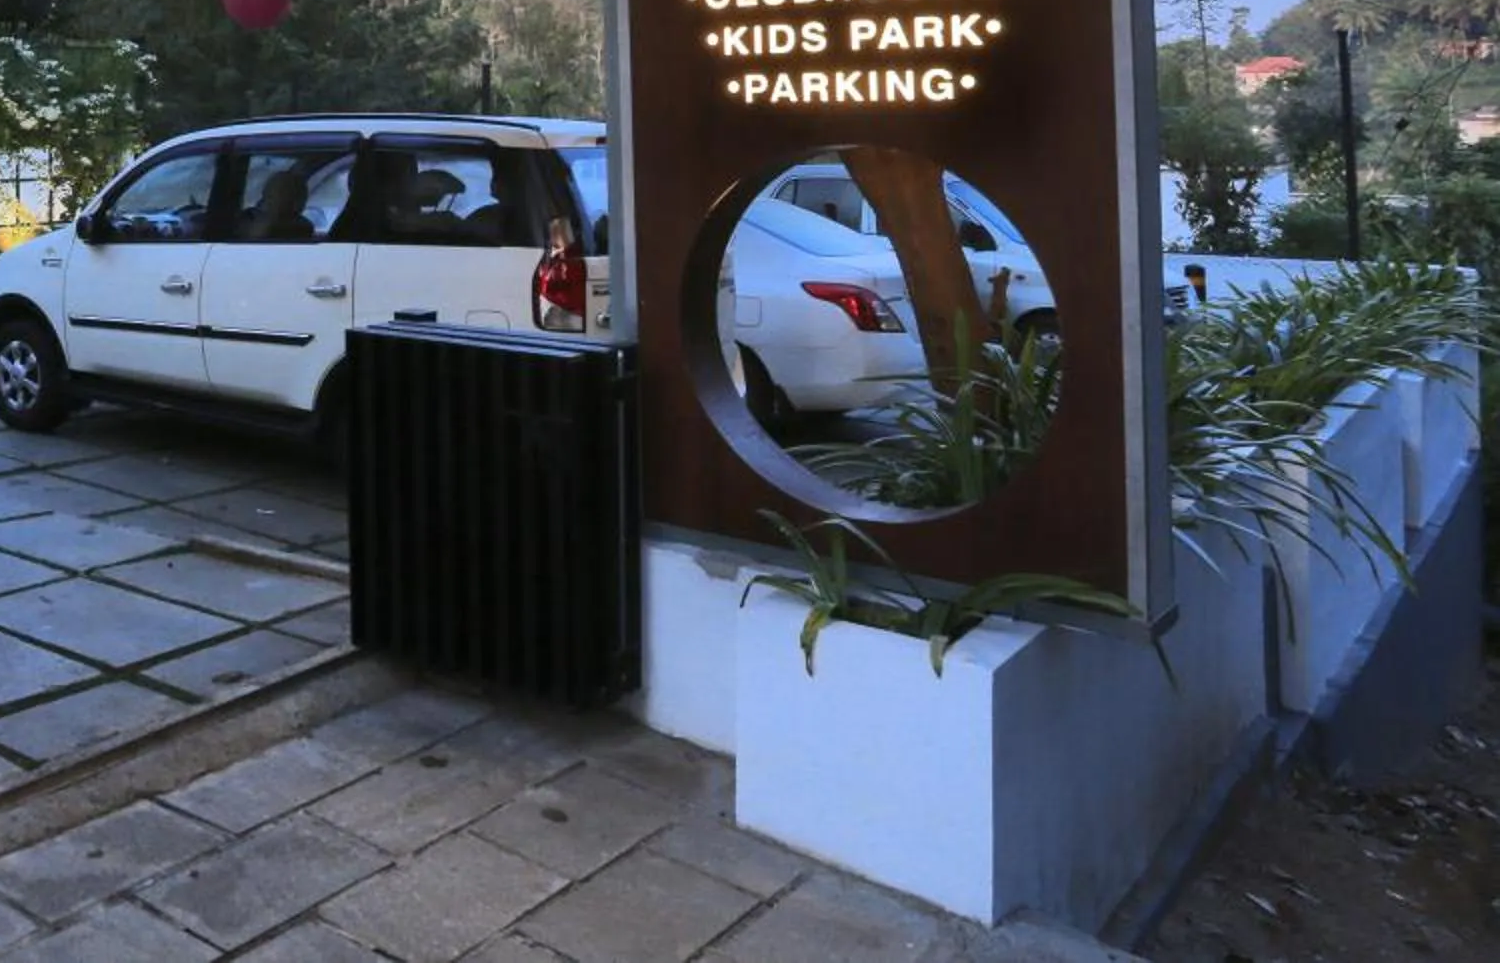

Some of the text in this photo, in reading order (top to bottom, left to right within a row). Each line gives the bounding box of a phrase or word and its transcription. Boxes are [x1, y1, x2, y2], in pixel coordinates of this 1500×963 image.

[723, 14, 984, 57] KIDS PARK
[745, 69, 955, 104] PARKING
